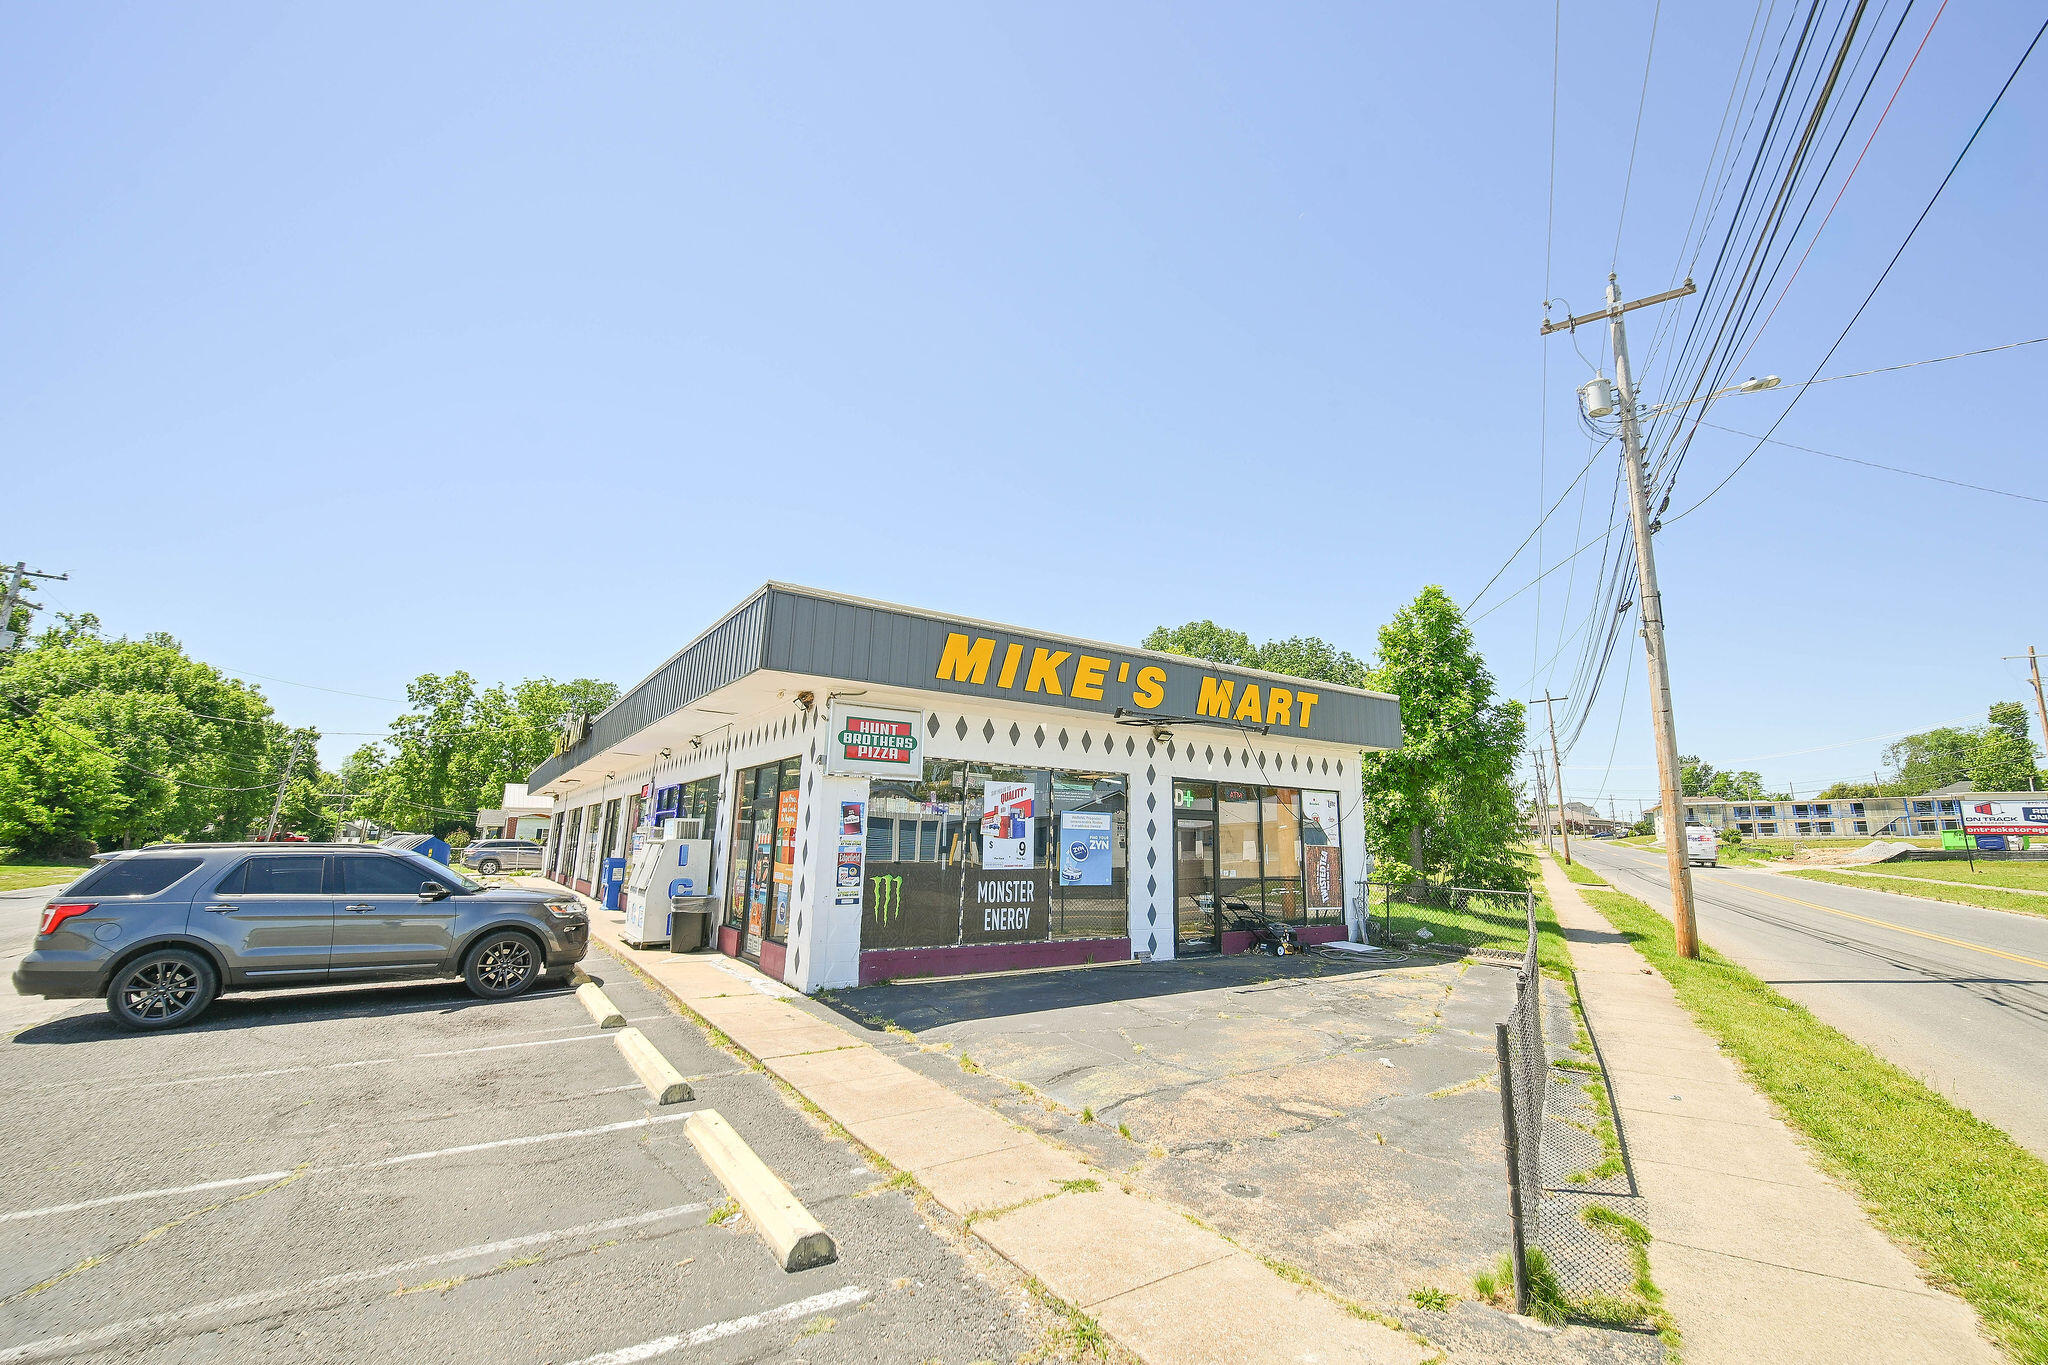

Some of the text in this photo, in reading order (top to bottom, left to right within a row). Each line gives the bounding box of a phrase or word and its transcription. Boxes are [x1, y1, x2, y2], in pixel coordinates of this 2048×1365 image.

[936, 632, 1319, 728] MIKE'S MART
[860, 721, 898, 735] HUNT
[843, 732, 913, 748] BROTHERS
[858, 745, 899, 760] PIZZA
[989, 841, 1026, 856] $ 9
[1089, 840, 1109, 850] ZYN
[665, 844, 694, 936] IC
[977, 880, 1034, 904] MONSTER
[1319, 866, 1330, 903] TWISTED
[984, 907, 1031, 931] ENERGY
